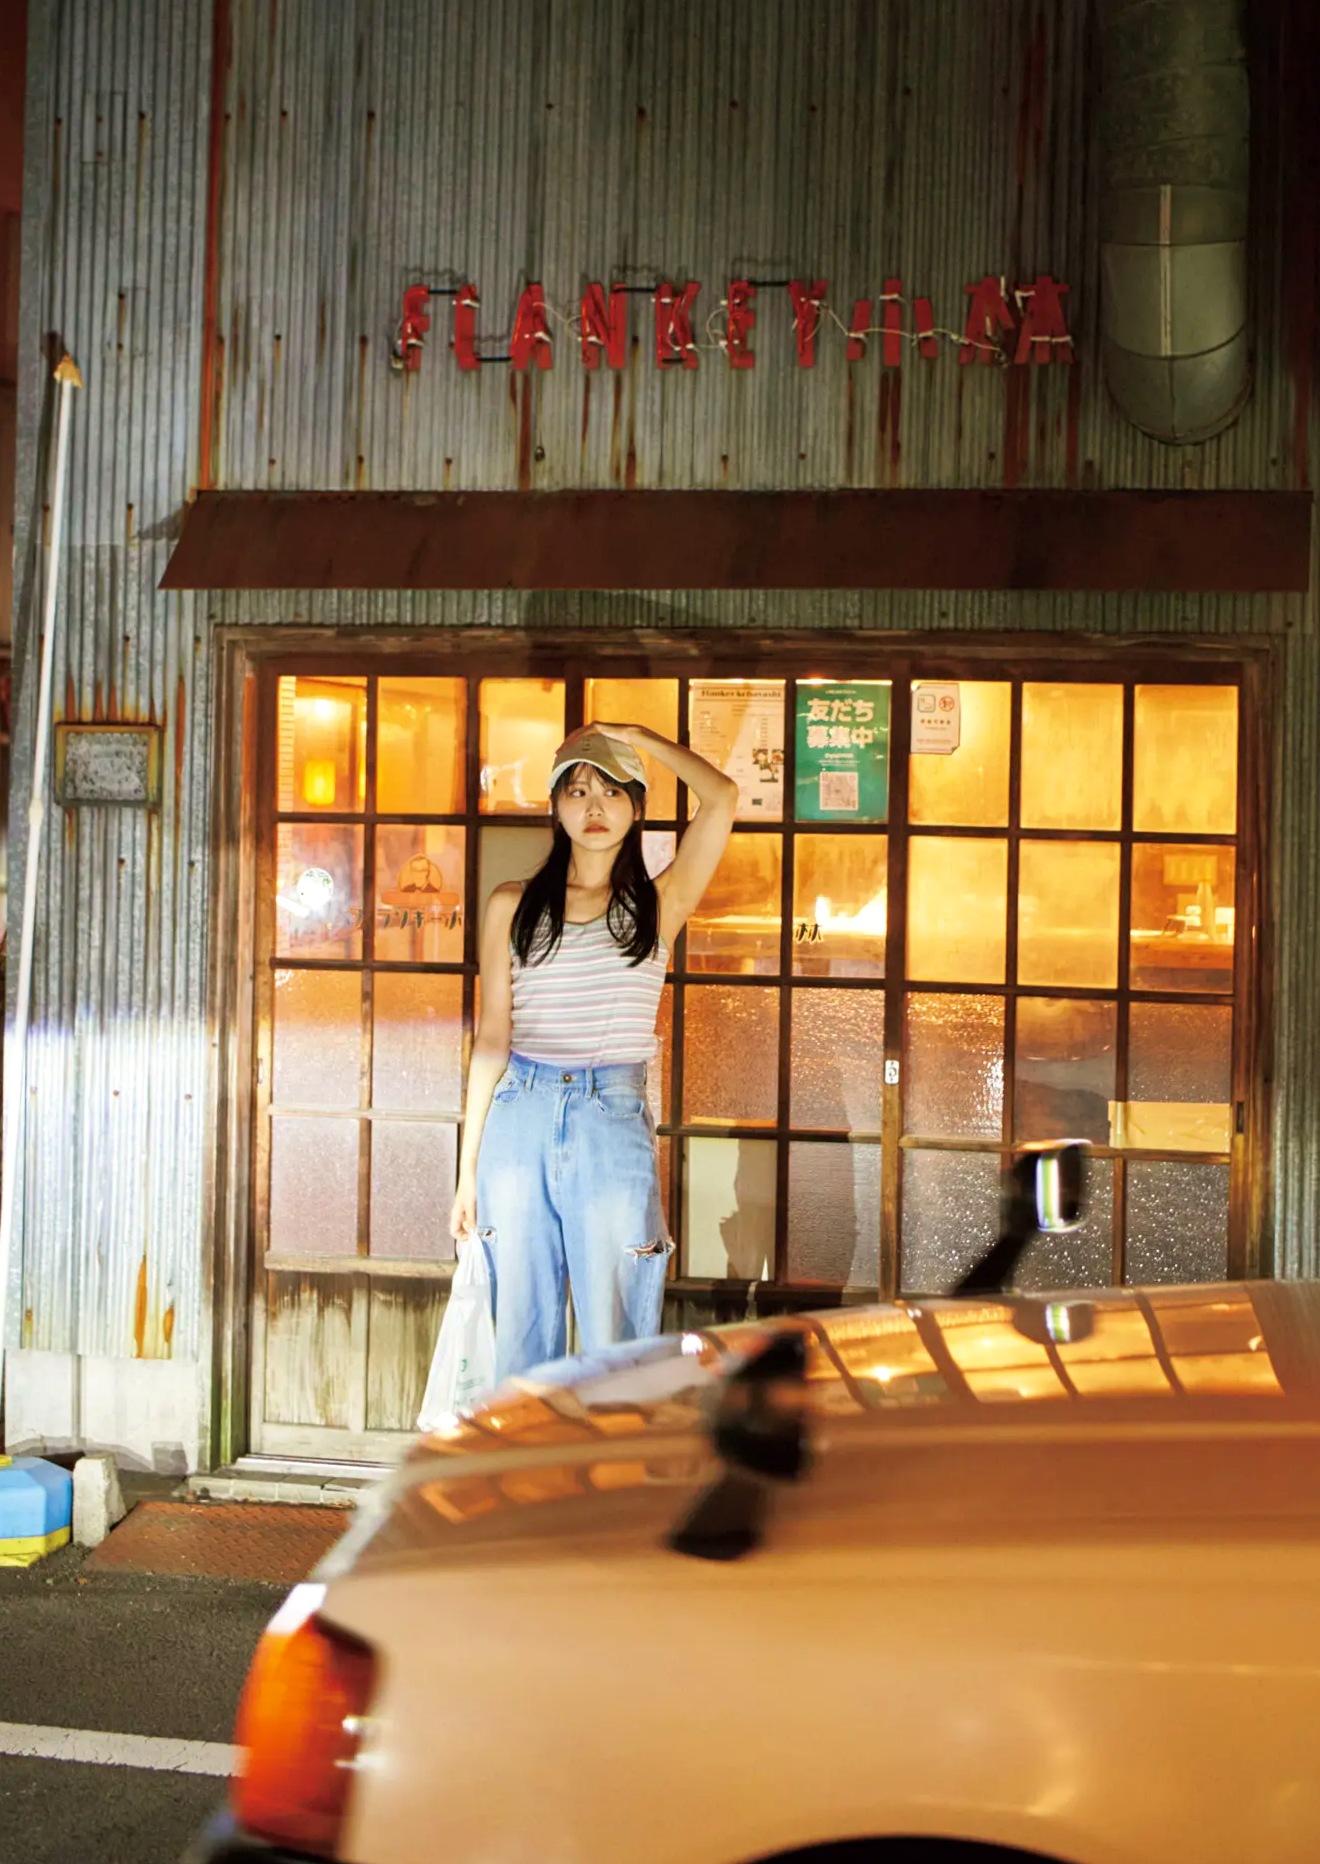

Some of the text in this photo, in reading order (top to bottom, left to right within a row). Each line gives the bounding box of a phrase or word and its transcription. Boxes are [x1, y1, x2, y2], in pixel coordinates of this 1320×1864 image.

[402, 280, 829, 370] FLANKEY
[807, 698, 874, 722] 友だち
[807, 725, 874, 749] 募集中
